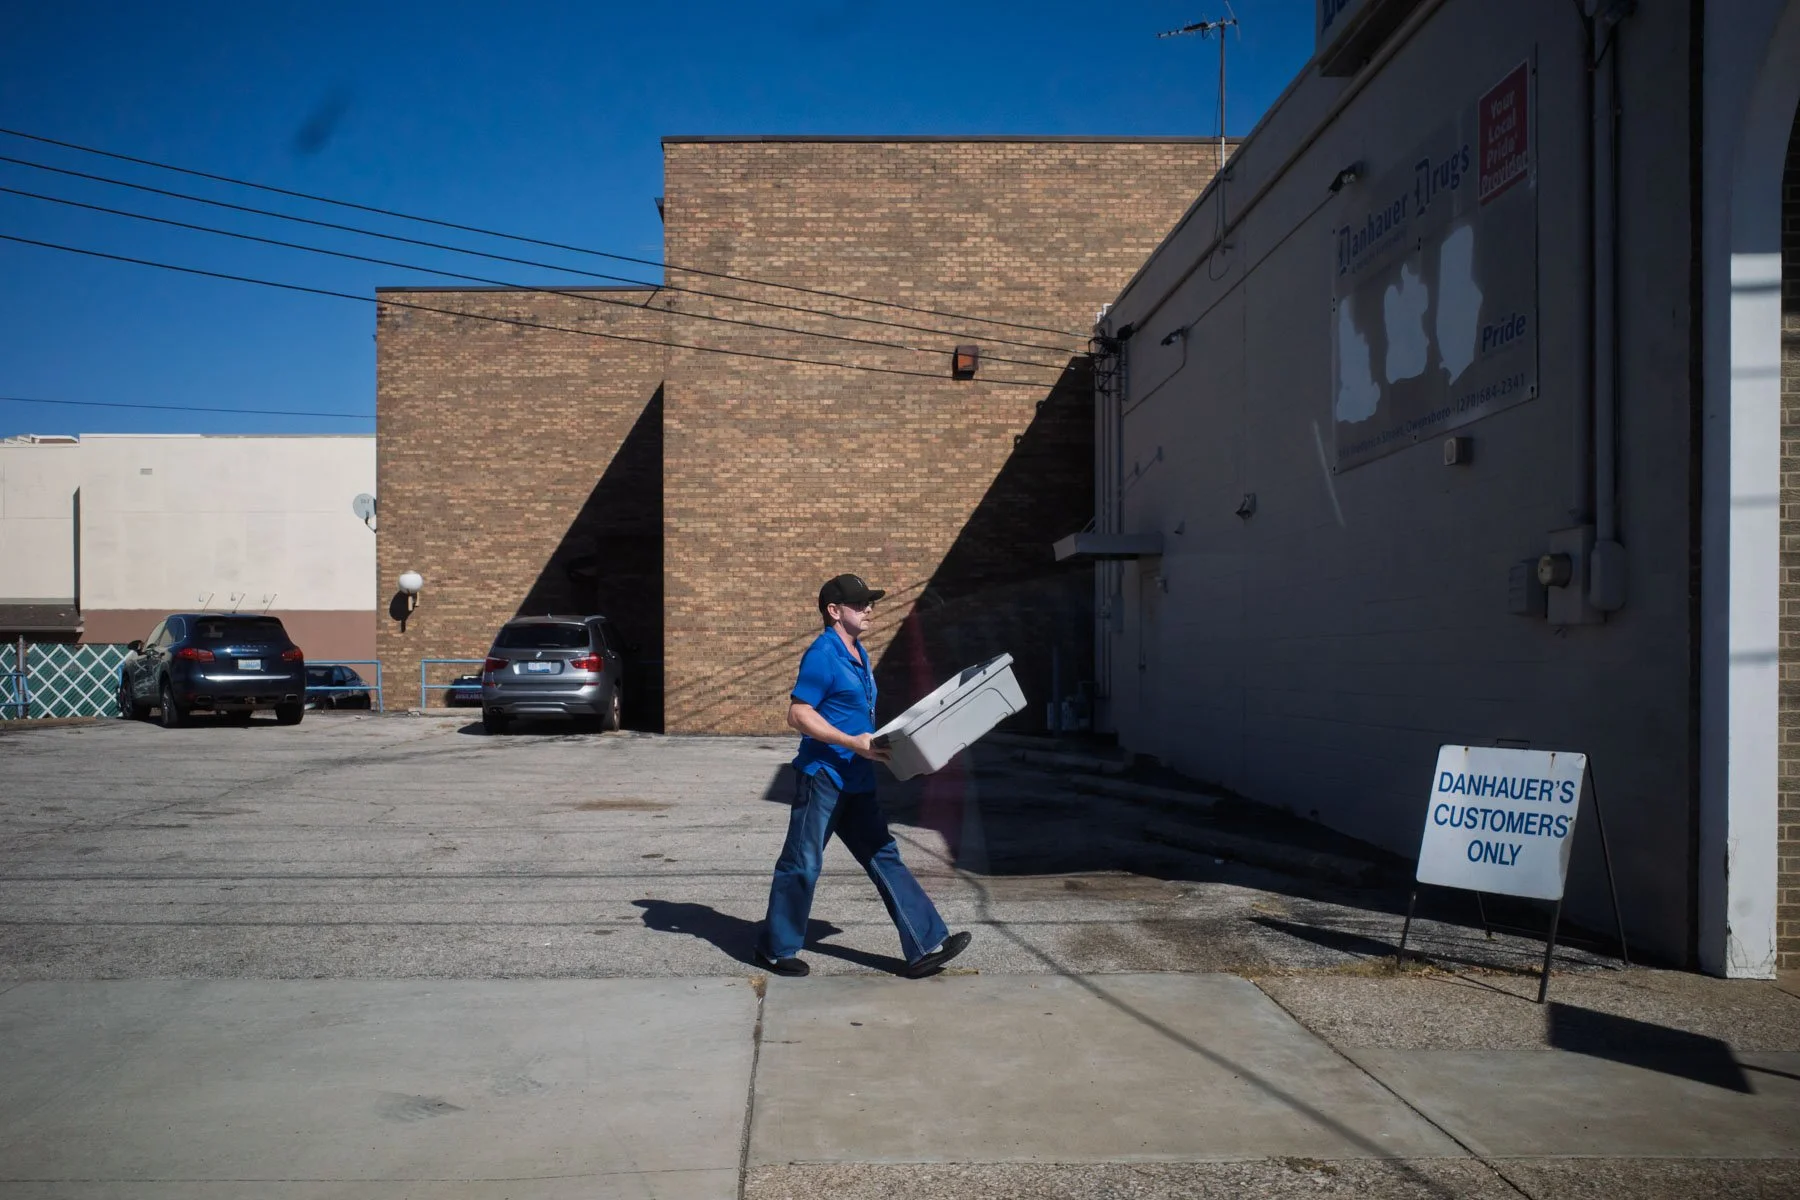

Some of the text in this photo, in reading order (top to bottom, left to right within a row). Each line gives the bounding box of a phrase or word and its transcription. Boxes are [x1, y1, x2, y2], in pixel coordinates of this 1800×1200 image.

[1491, 90, 1515, 119] Your
[1489, 107, 1517, 144] Local
[1339, 193, 1408, 276] Danhauer
[1414, 143, 1470, 217] Drugs
[1482, 312, 1526, 353] Pride
[1438, 771, 1575, 804] DANHAUER'S
[1434, 803, 1568, 838] CUSTOMERS
[1467, 840, 1523, 866] ONLY
